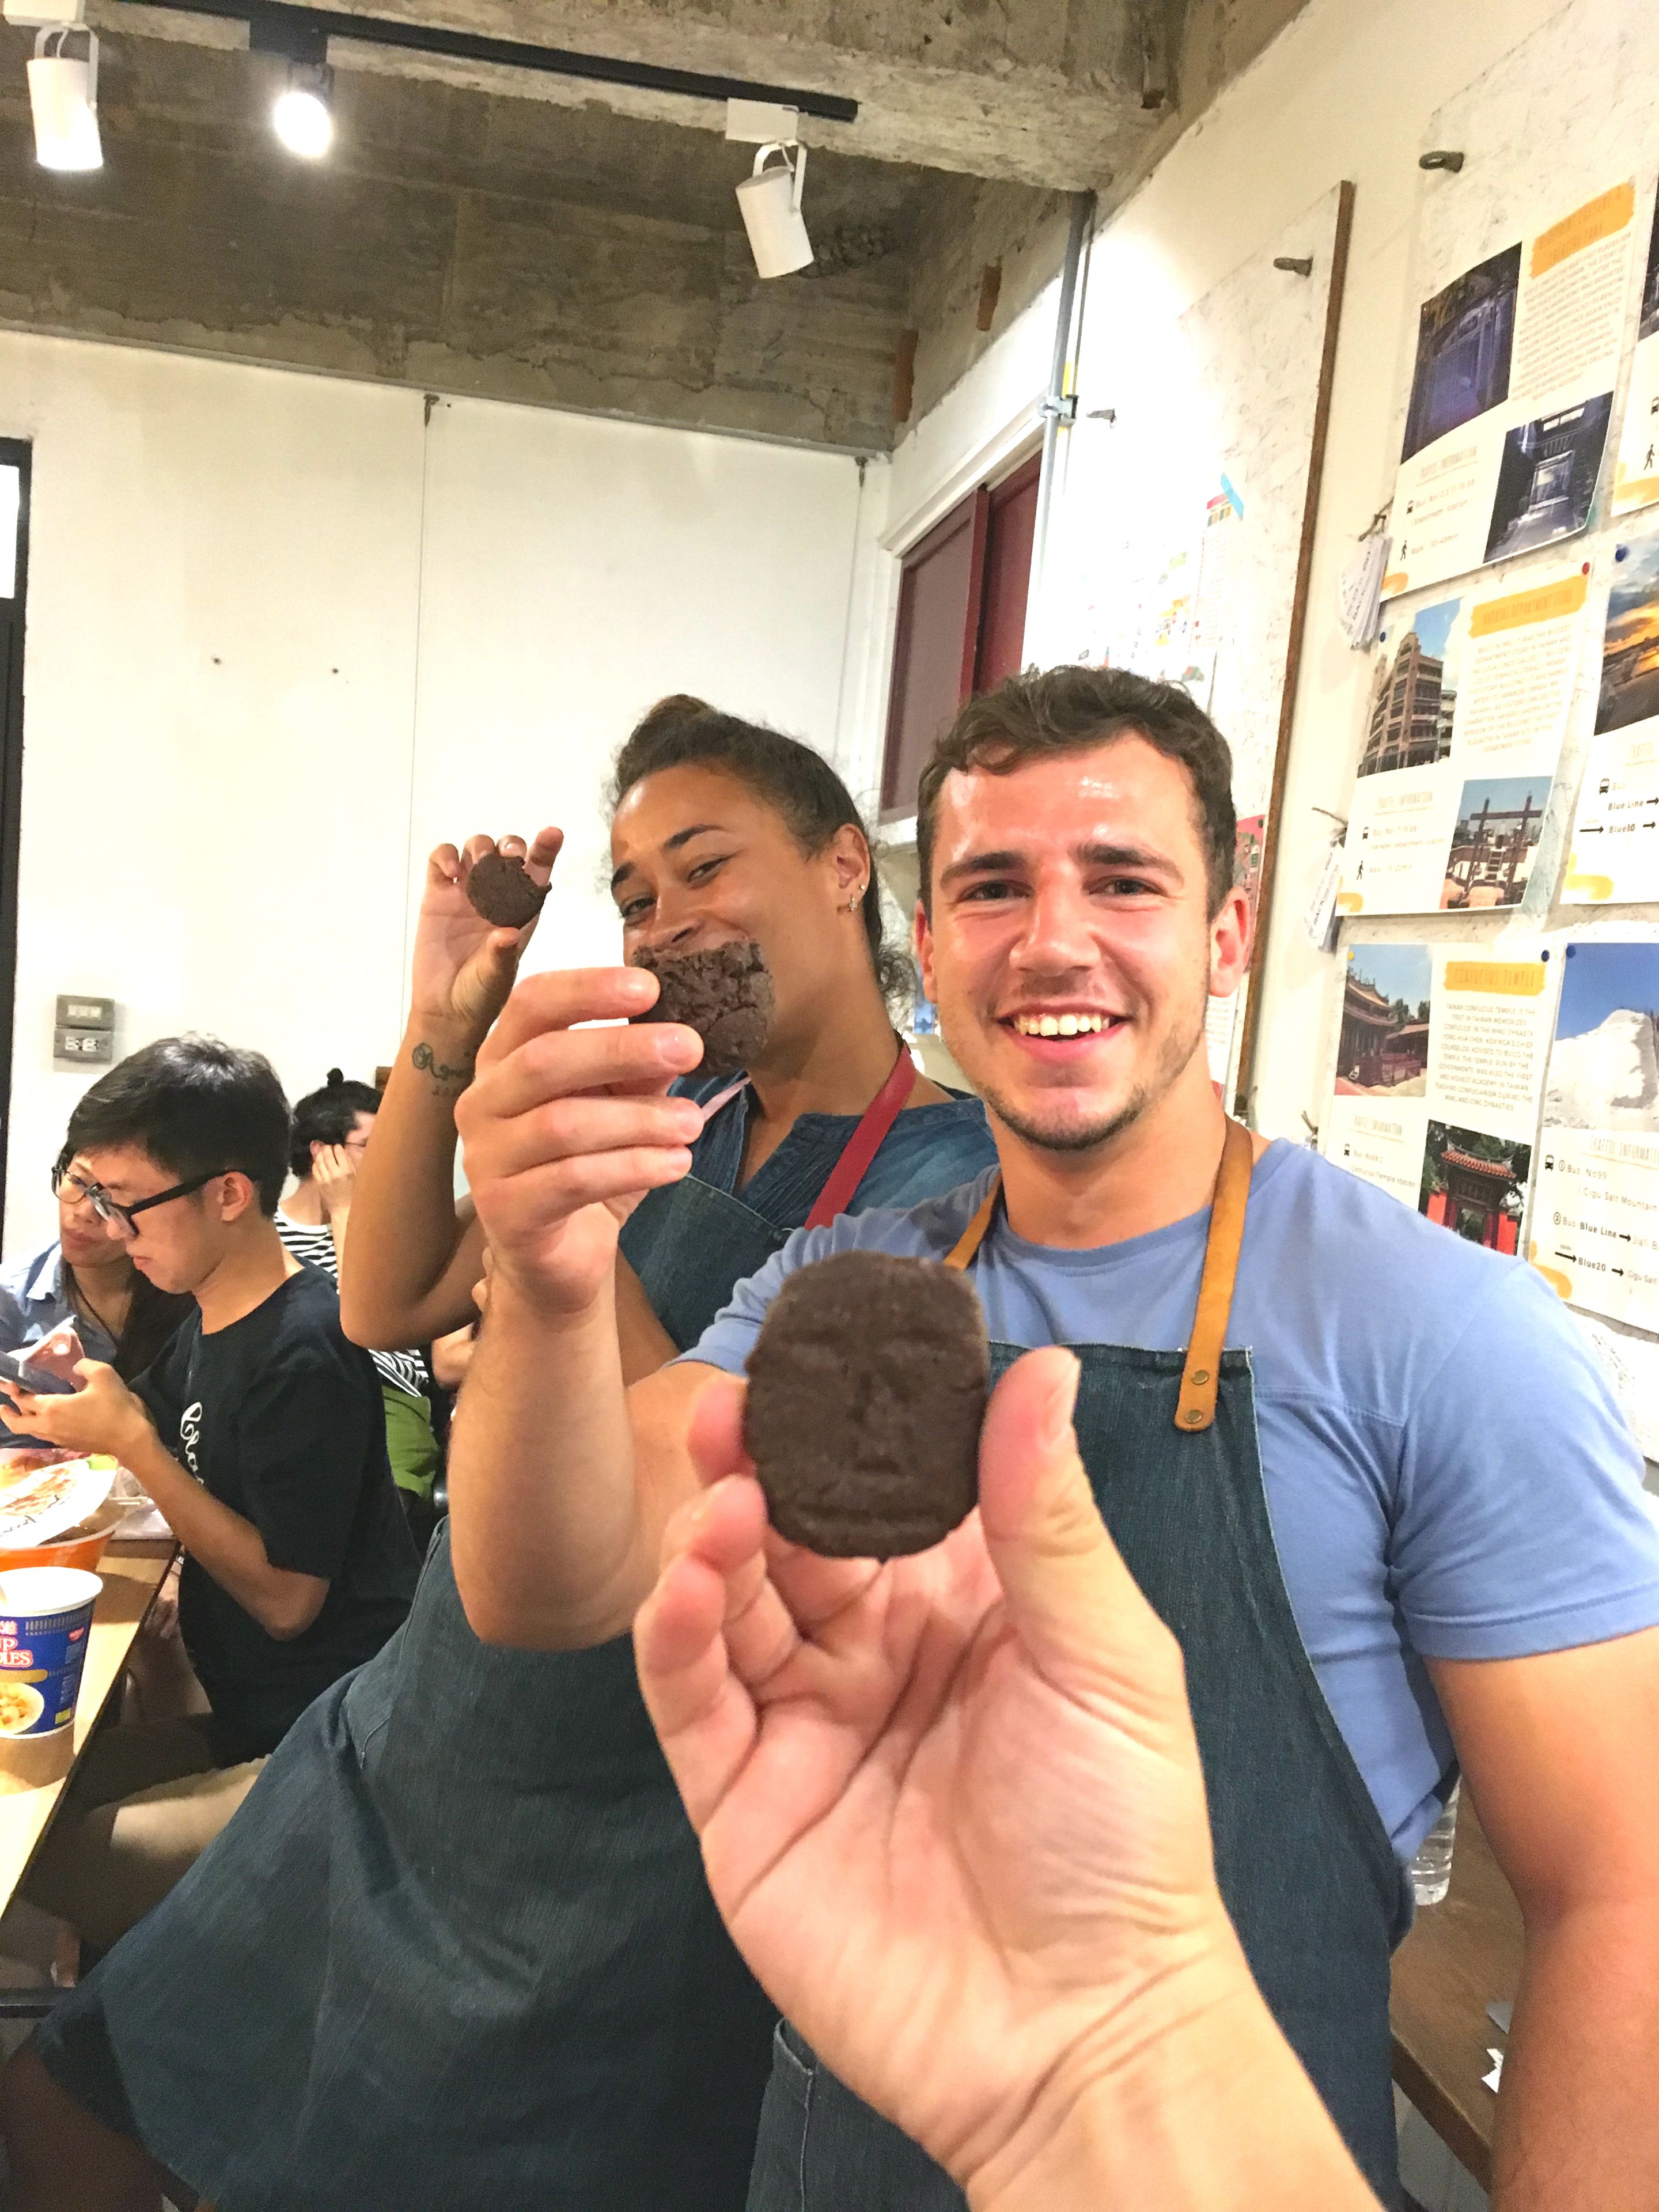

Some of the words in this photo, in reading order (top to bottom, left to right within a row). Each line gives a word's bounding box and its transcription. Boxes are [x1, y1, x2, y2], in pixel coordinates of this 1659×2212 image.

[1608, 802, 1625, 811] Blue
[1627, 800, 1644, 809] Line
[1455, 968, 1499, 986] CONFUCIUS
[1504, 969, 1536, 987] TEMPLE
[1590, 1135, 1615, 1155] TRAFFIC
[1604, 1192, 1619, 1202] Salt
[1620, 1196, 1658, 1212] Mountain
[1580, 1222, 1598, 1233] Blue
[1600, 1226, 1618, 1238] Line
[1652, 1241, 1659, 1250] B
[1578, 1257, 1607, 1272] Blue20
[1644, 1274, 1657, 1285] Salt
[0, 1638, 16, 1652] P
[0, 1651, 31, 1666] LES
